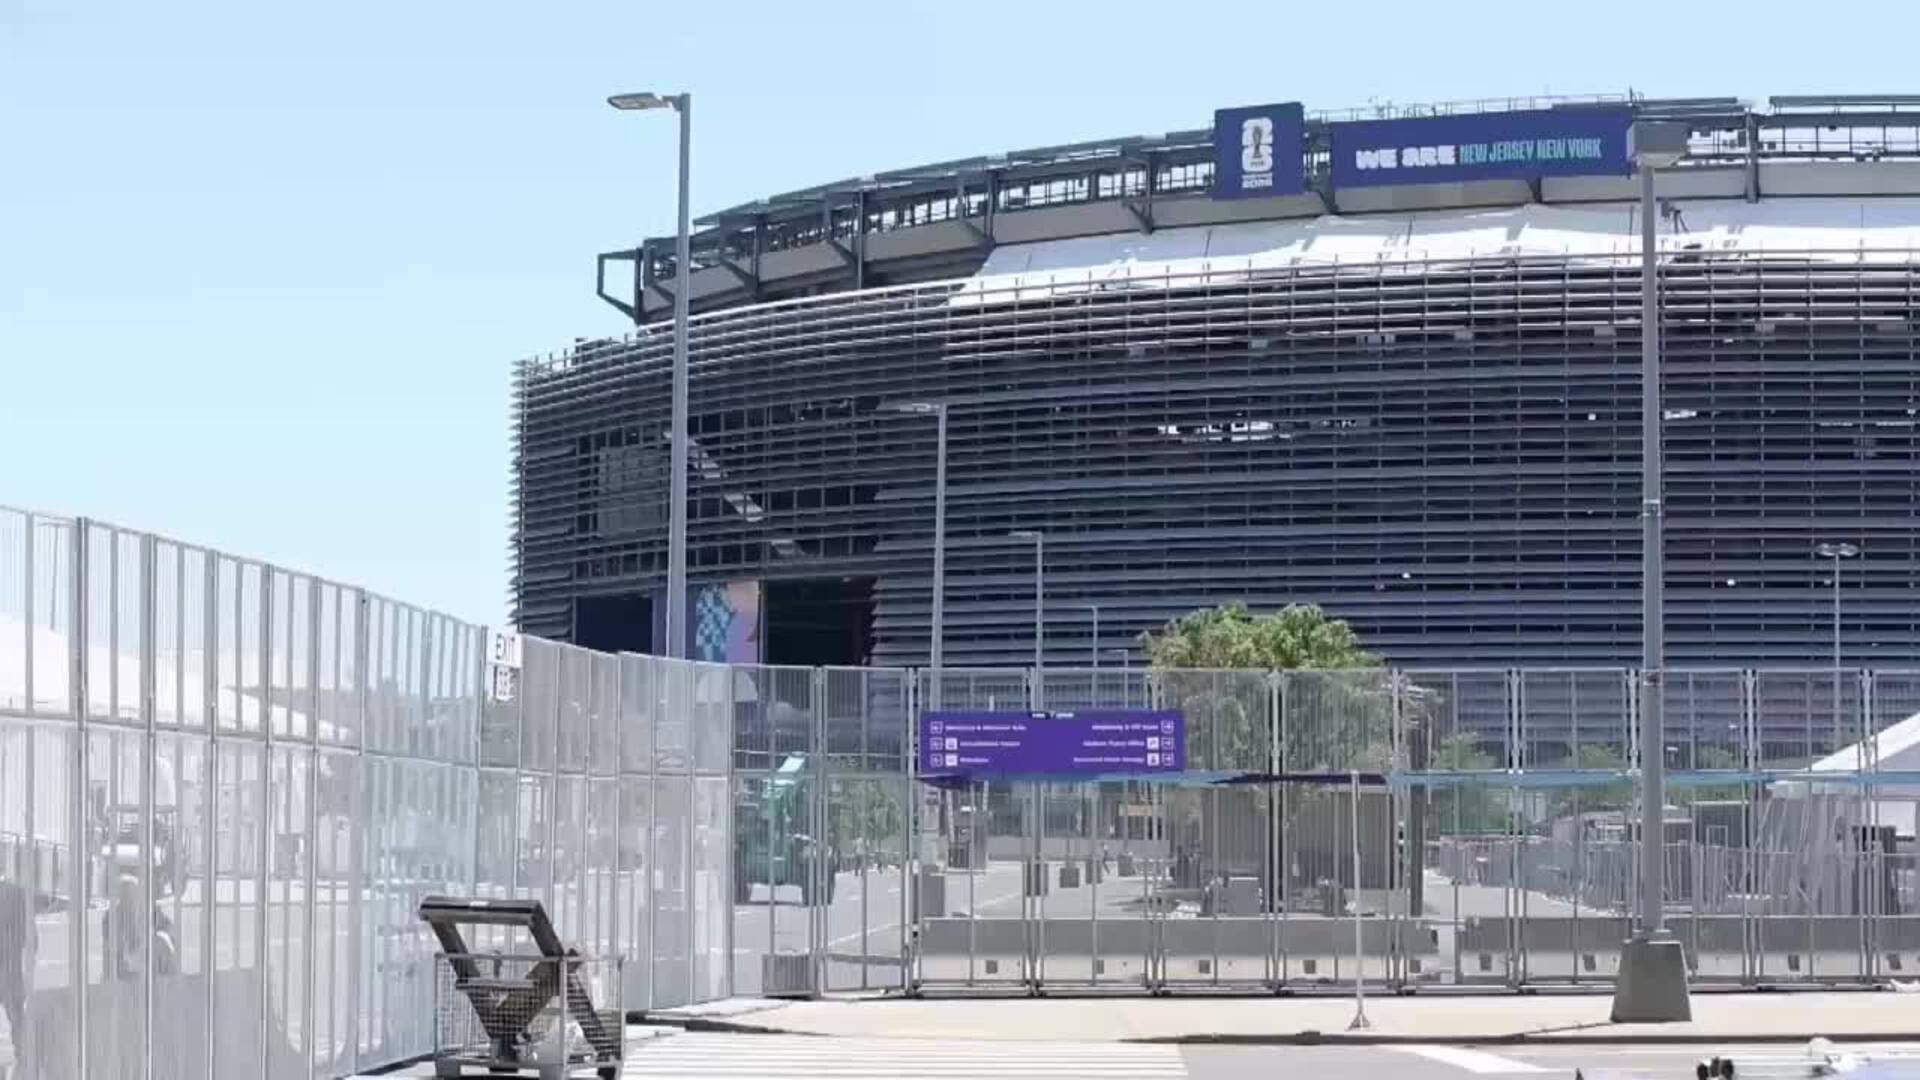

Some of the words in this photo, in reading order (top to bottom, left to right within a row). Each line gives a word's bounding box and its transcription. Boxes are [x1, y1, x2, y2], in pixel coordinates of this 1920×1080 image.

[1356, 149, 1397, 170] WE
[1402, 145, 1455, 167] ARE
[1460, 143, 1487, 165] NEW
[1489, 140, 1534, 162] JERSEY
[1537, 137, 1566, 160] NEW
[1568, 137, 1602, 159] YORK
